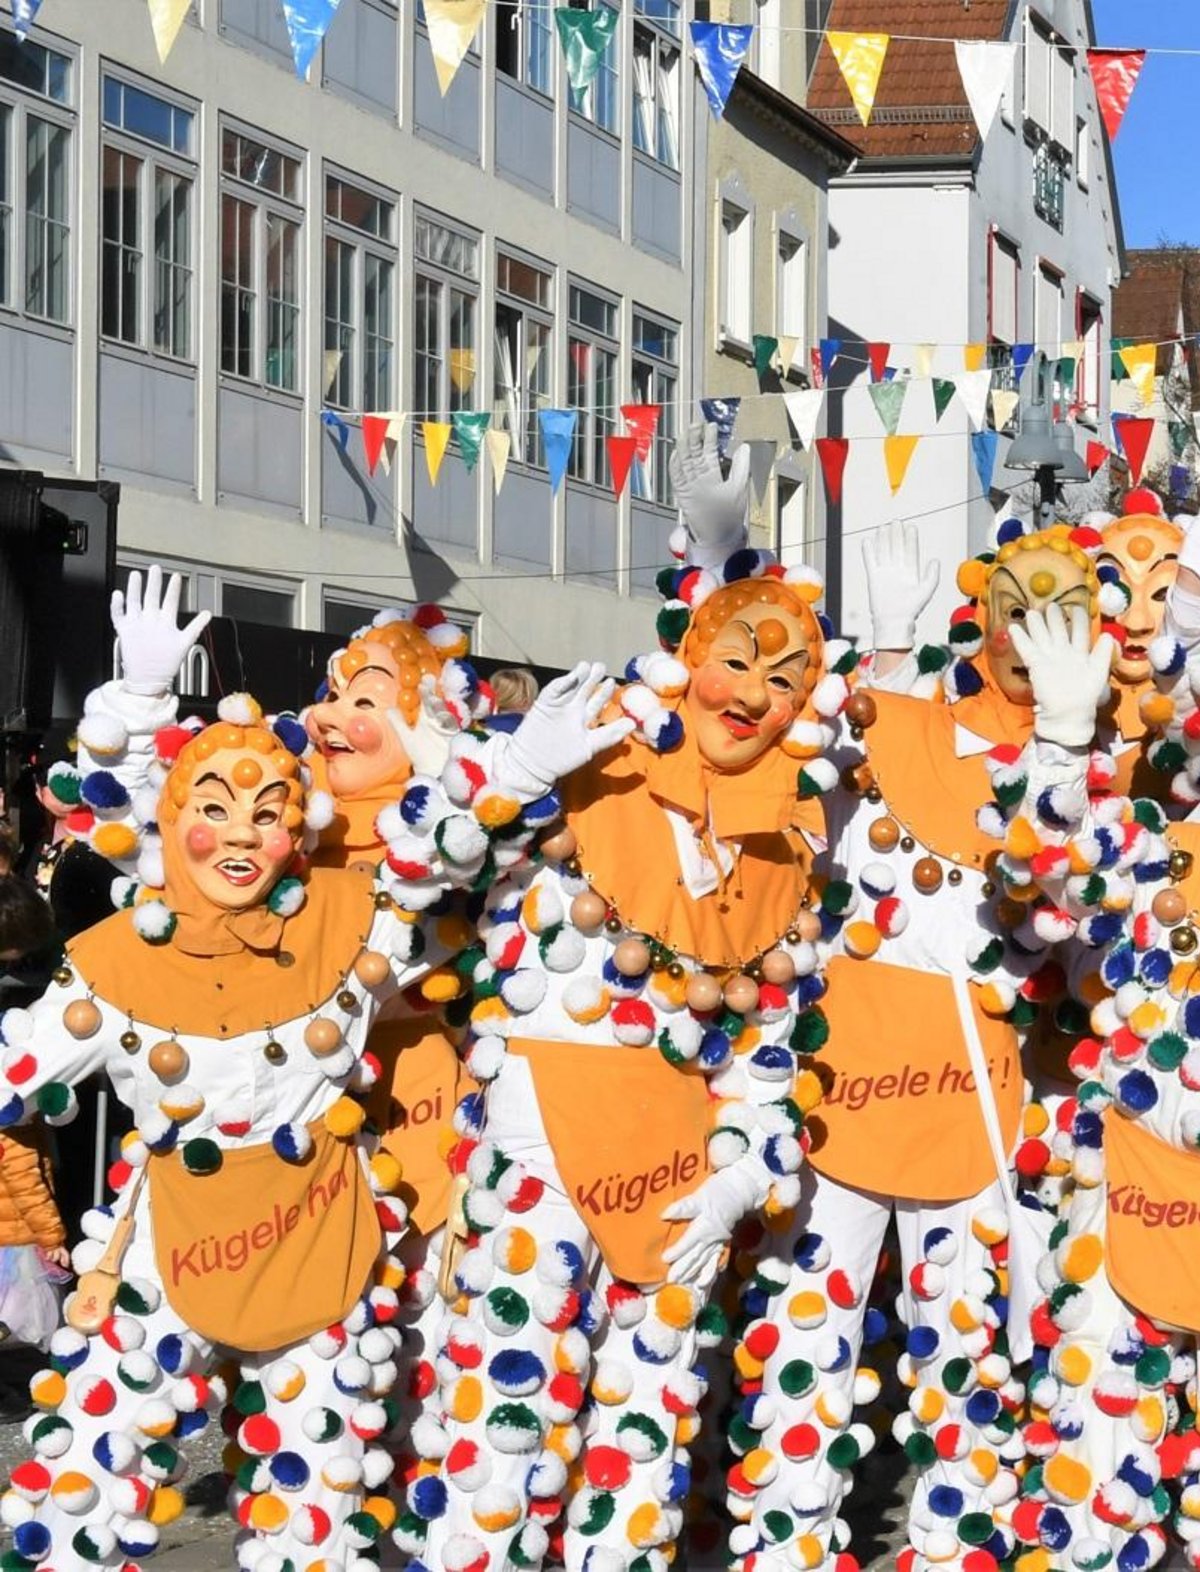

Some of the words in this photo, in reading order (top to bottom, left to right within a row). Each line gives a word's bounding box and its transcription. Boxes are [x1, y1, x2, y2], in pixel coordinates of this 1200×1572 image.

[824, 1064, 930, 1111] ügele
[1001, 1057, 1010, 1089] !
[577, 1149, 699, 1216] Kügele
[171, 1204, 301, 1288] Kügele
